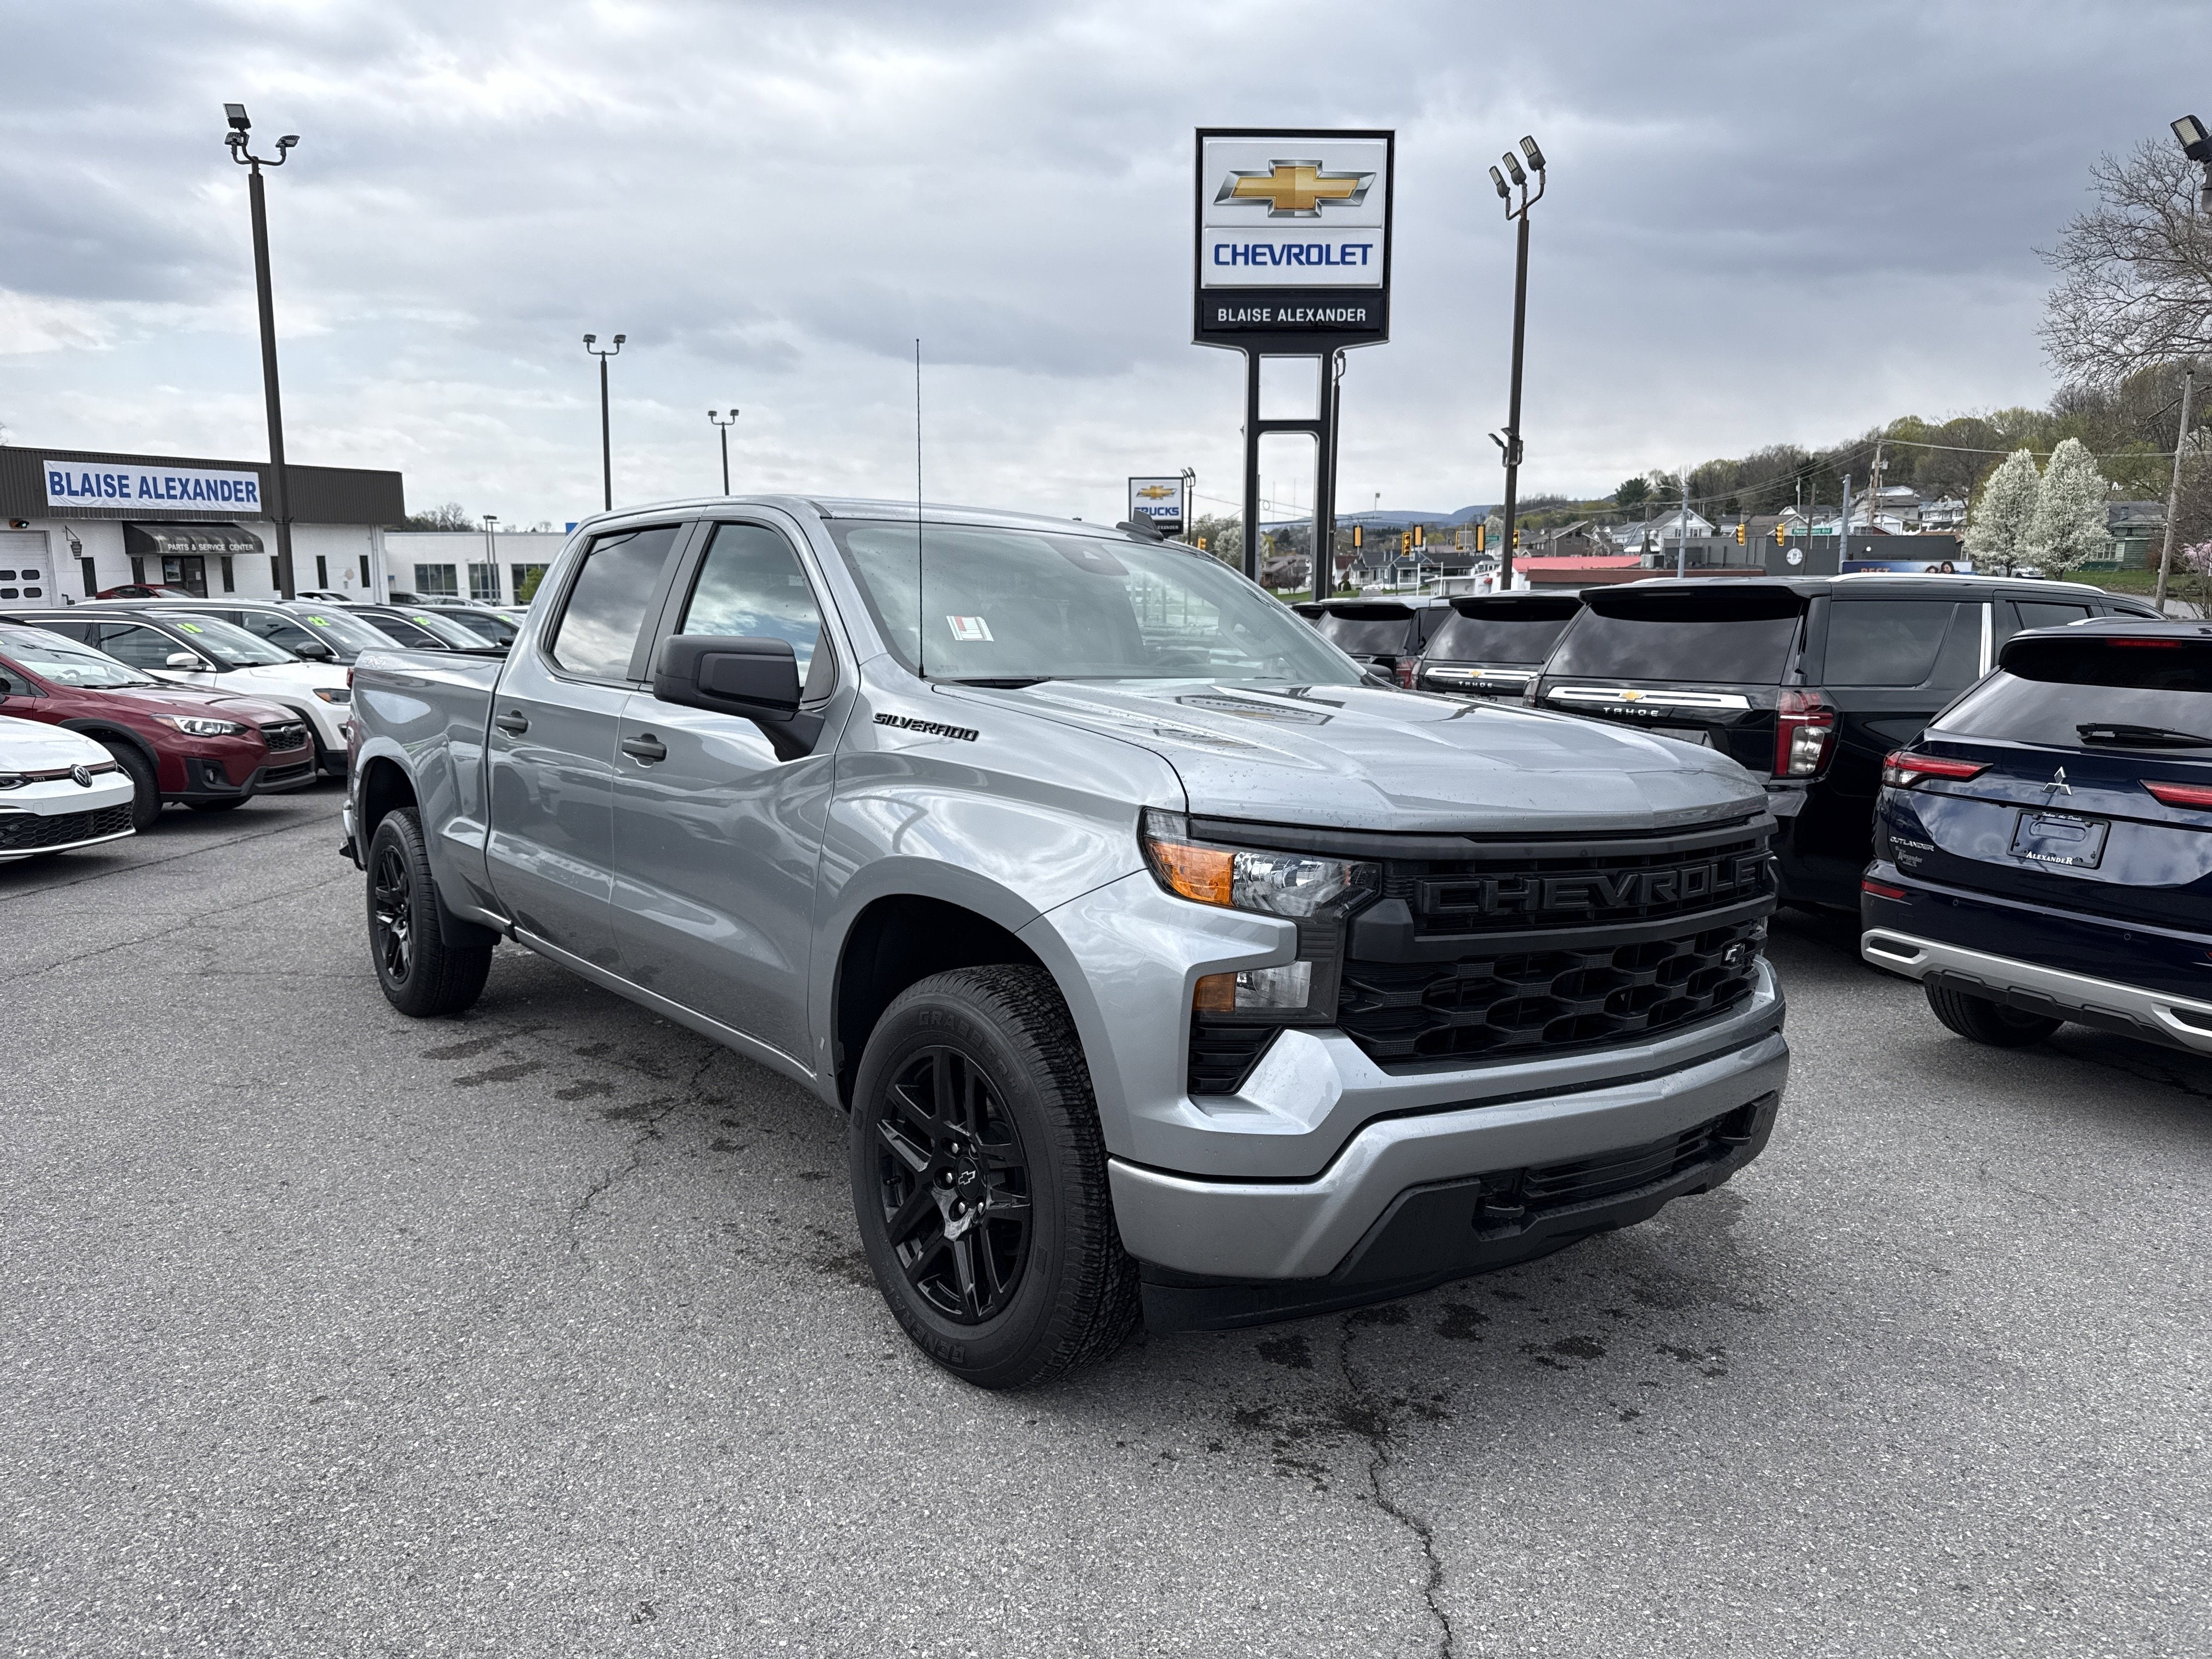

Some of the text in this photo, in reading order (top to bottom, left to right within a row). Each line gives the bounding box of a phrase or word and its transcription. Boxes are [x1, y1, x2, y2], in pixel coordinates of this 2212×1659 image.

[1214, 244, 1373, 266] CHEVROLET
[1217, 308, 1366, 322] BLAISE ALEXANDER
[48, 471, 258, 503] BLAISE ALEXANDER
[167, 543, 190, 551] PARTS
[1602, 707, 1659, 717] TAHOE
[873, 712, 979, 742] SILVERADO
[1889, 836, 1934, 852] OUTLANDER
[2025, 851, 2073, 865] ALEXANDER
[1421, 850, 1774, 915] CHEVROLET
[918, 1011, 1008, 1079] GRABBER
